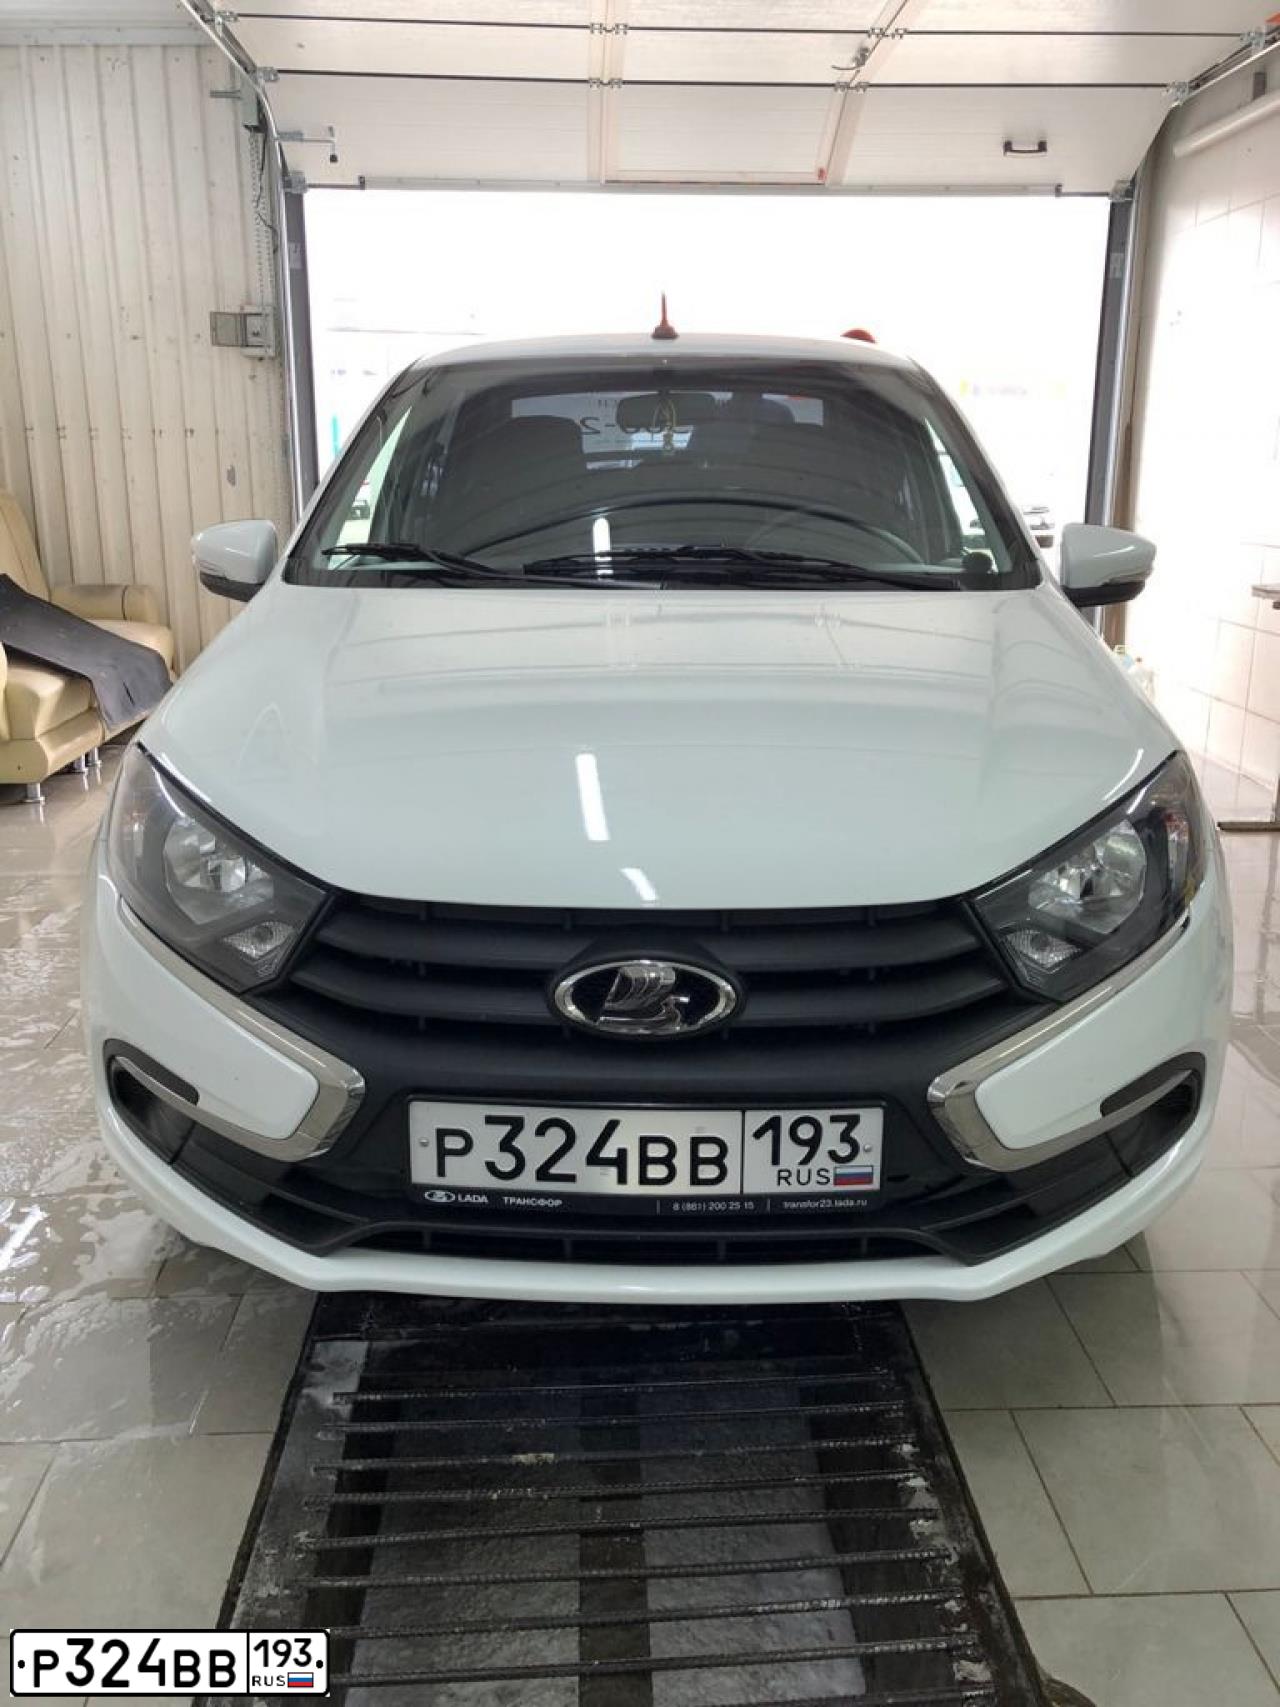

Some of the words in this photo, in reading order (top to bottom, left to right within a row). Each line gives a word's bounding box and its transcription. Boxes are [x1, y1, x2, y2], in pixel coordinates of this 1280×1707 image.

[752, 1114, 861, 1166] 193
[777, 1168, 831, 1186] RUS
[457, 1194, 489, 1203] LADA
[502, 1196, 563, 1207] ТРАНСФОР
[708, 1201, 727, 1211] 200
